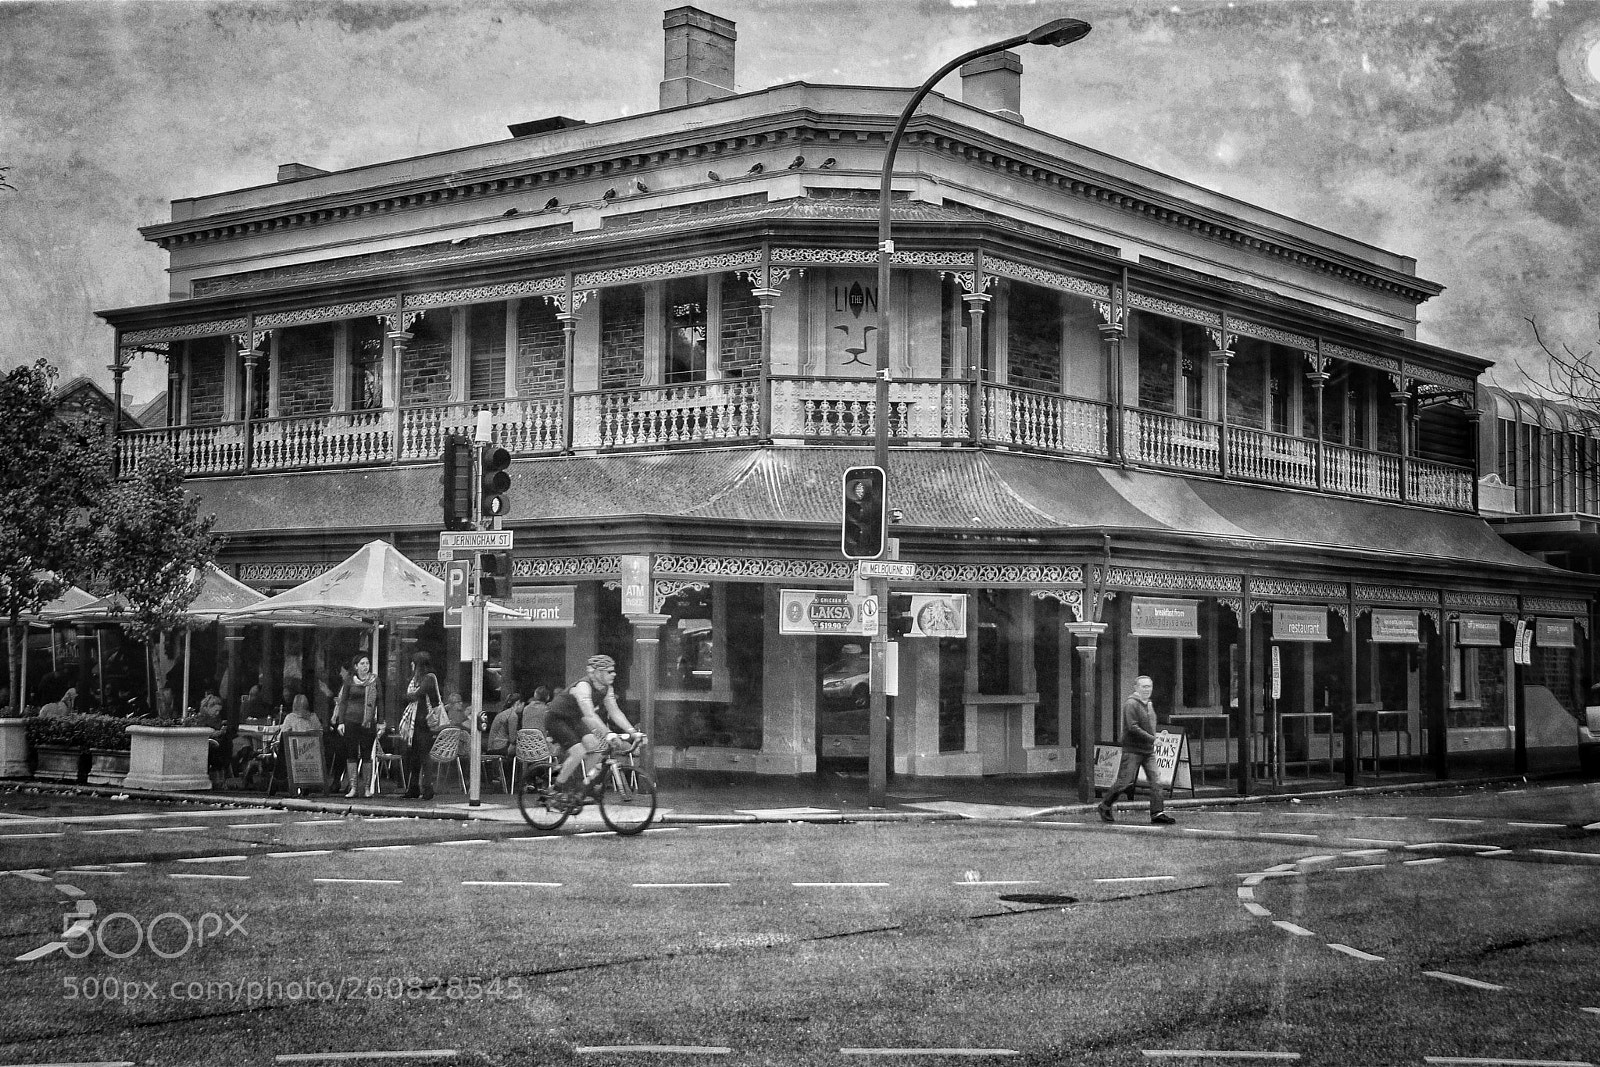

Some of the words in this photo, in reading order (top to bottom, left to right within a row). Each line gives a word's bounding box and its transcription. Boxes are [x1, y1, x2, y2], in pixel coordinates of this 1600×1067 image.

[834, 282, 878, 317] LION
[850, 294, 863, 304] THE
[452, 534, 496, 546] JERNINGHAM
[499, 534, 508, 545] ST
[870, 563, 904, 575] MELBOURNE
[905, 565, 913, 575] ST
[449, 568, 464, 597] P
[626, 584, 644, 596] ATM
[502, 606, 560, 620] taurant
[810, 606, 851, 619] LAKSA
[1288, 621, 1320, 634] restaurant
[1155, 744, 1176, 758] AM'S
[1155, 757, 1174, 769] OCK!
